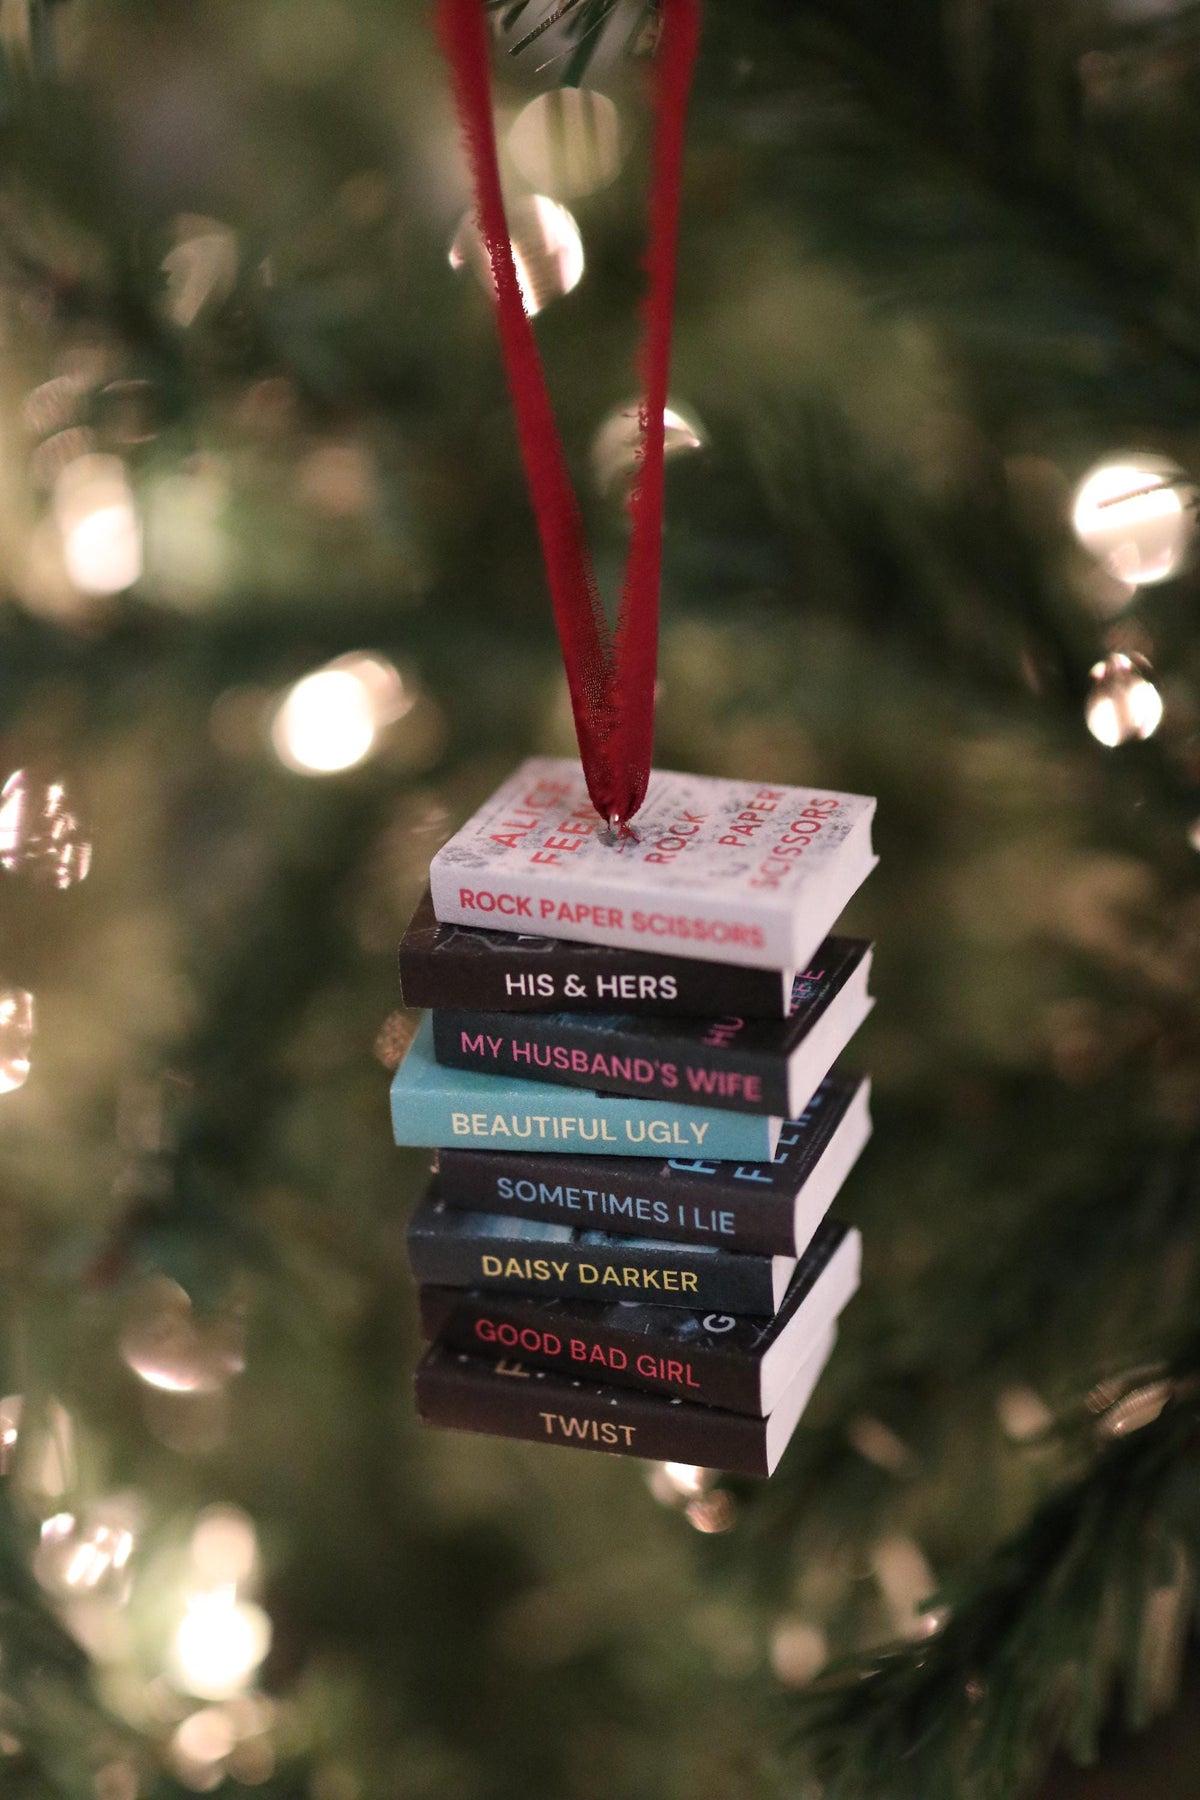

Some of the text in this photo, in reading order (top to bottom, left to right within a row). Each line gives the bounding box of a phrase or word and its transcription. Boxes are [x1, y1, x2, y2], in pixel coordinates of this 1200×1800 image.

[490, 780, 572, 848] ALICE
[643, 810, 709, 865] ROCK
[718, 790, 786, 847] PAPER
[750, 798, 839, 889] SCISSORS
[459, 888, 766, 949] ROCK PAPER SCISSORS
[505, 973, 678, 999] HIS & HERS
[461, 1031, 763, 1101] MY HUSBAND'S WIFE
[451, 1113, 709, 1145] BEAUTIFUL UGLY
[497, 1178, 736, 1235] SOMETIMES I LIE
[481, 1255, 698, 1293] DAISY DARKER
[474, 1318, 562, 1356] GOOD
[570, 1338, 628, 1371] BAD
[637, 1354, 701, 1388] GIRL
[539, 1411, 637, 1447] TWIST
